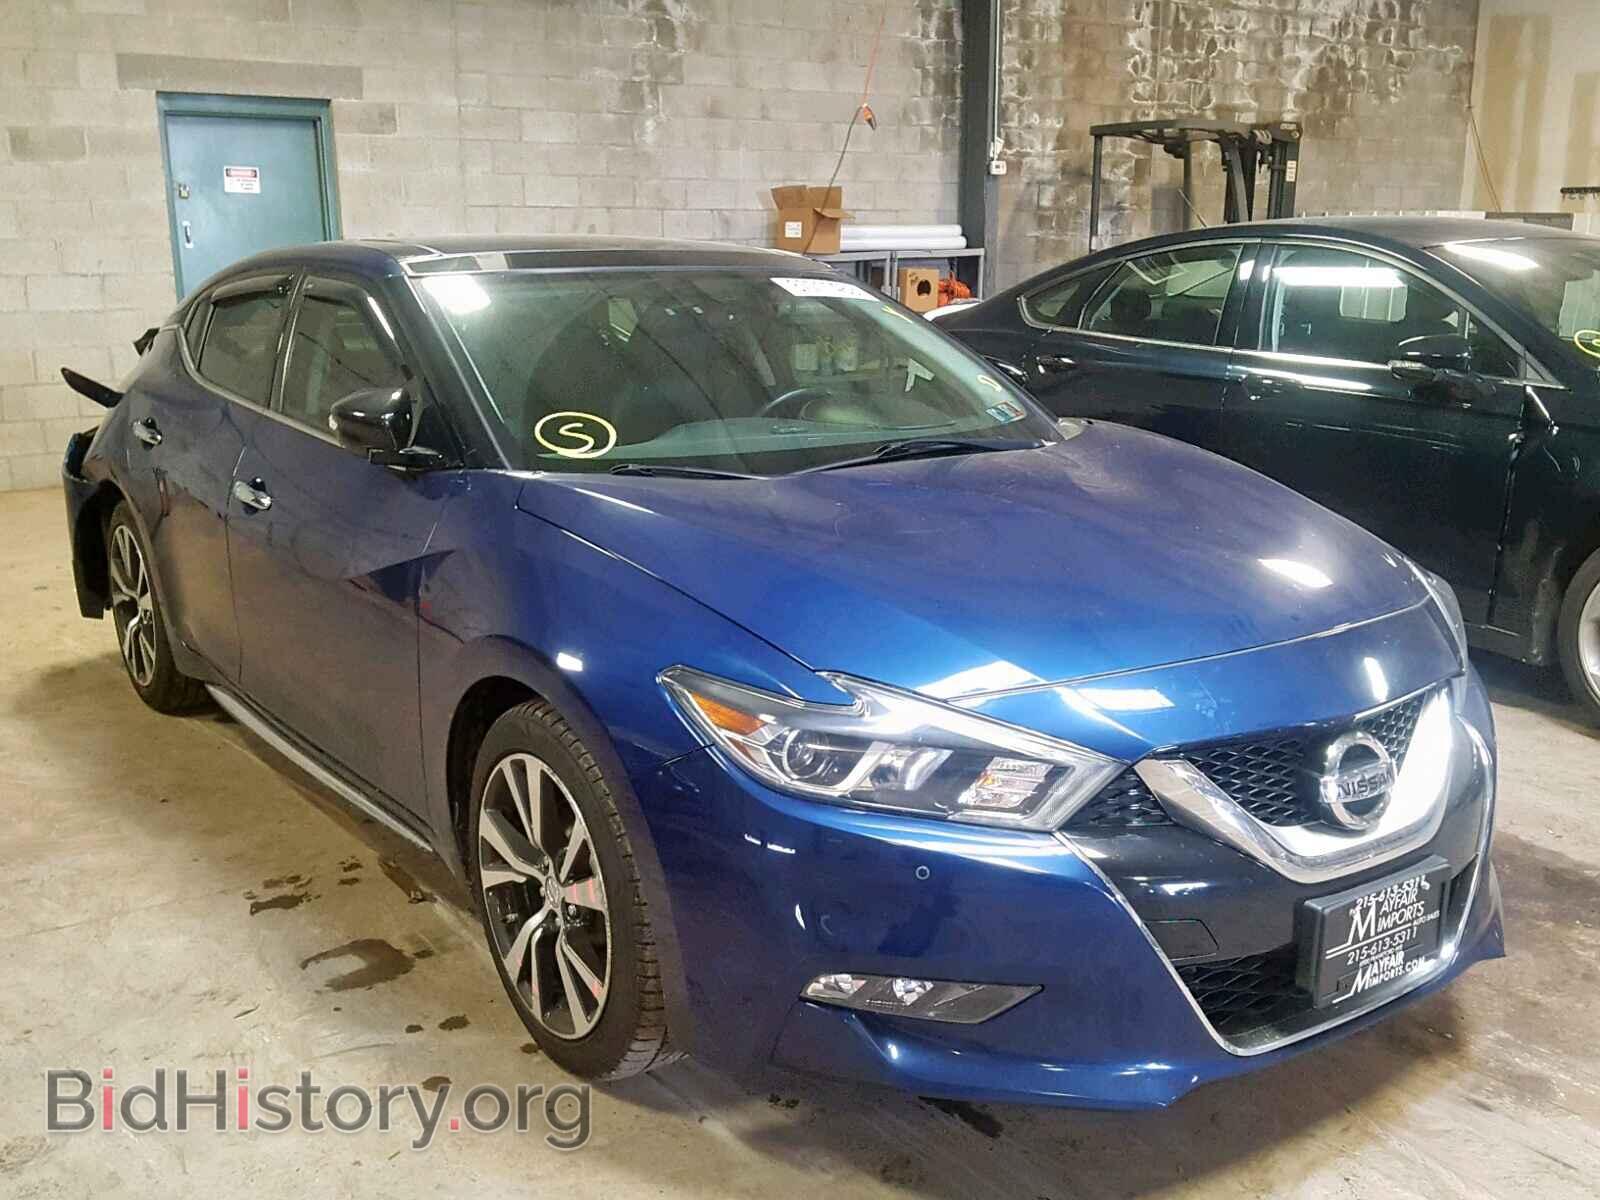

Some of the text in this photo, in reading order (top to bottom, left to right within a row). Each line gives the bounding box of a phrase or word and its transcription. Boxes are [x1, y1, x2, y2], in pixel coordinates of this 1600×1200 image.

[1337, 767, 1394, 798] NISSAN
[1377, 901, 1425, 933] IMPORTS
[1347, 926, 1417, 966] 215-613-5311
